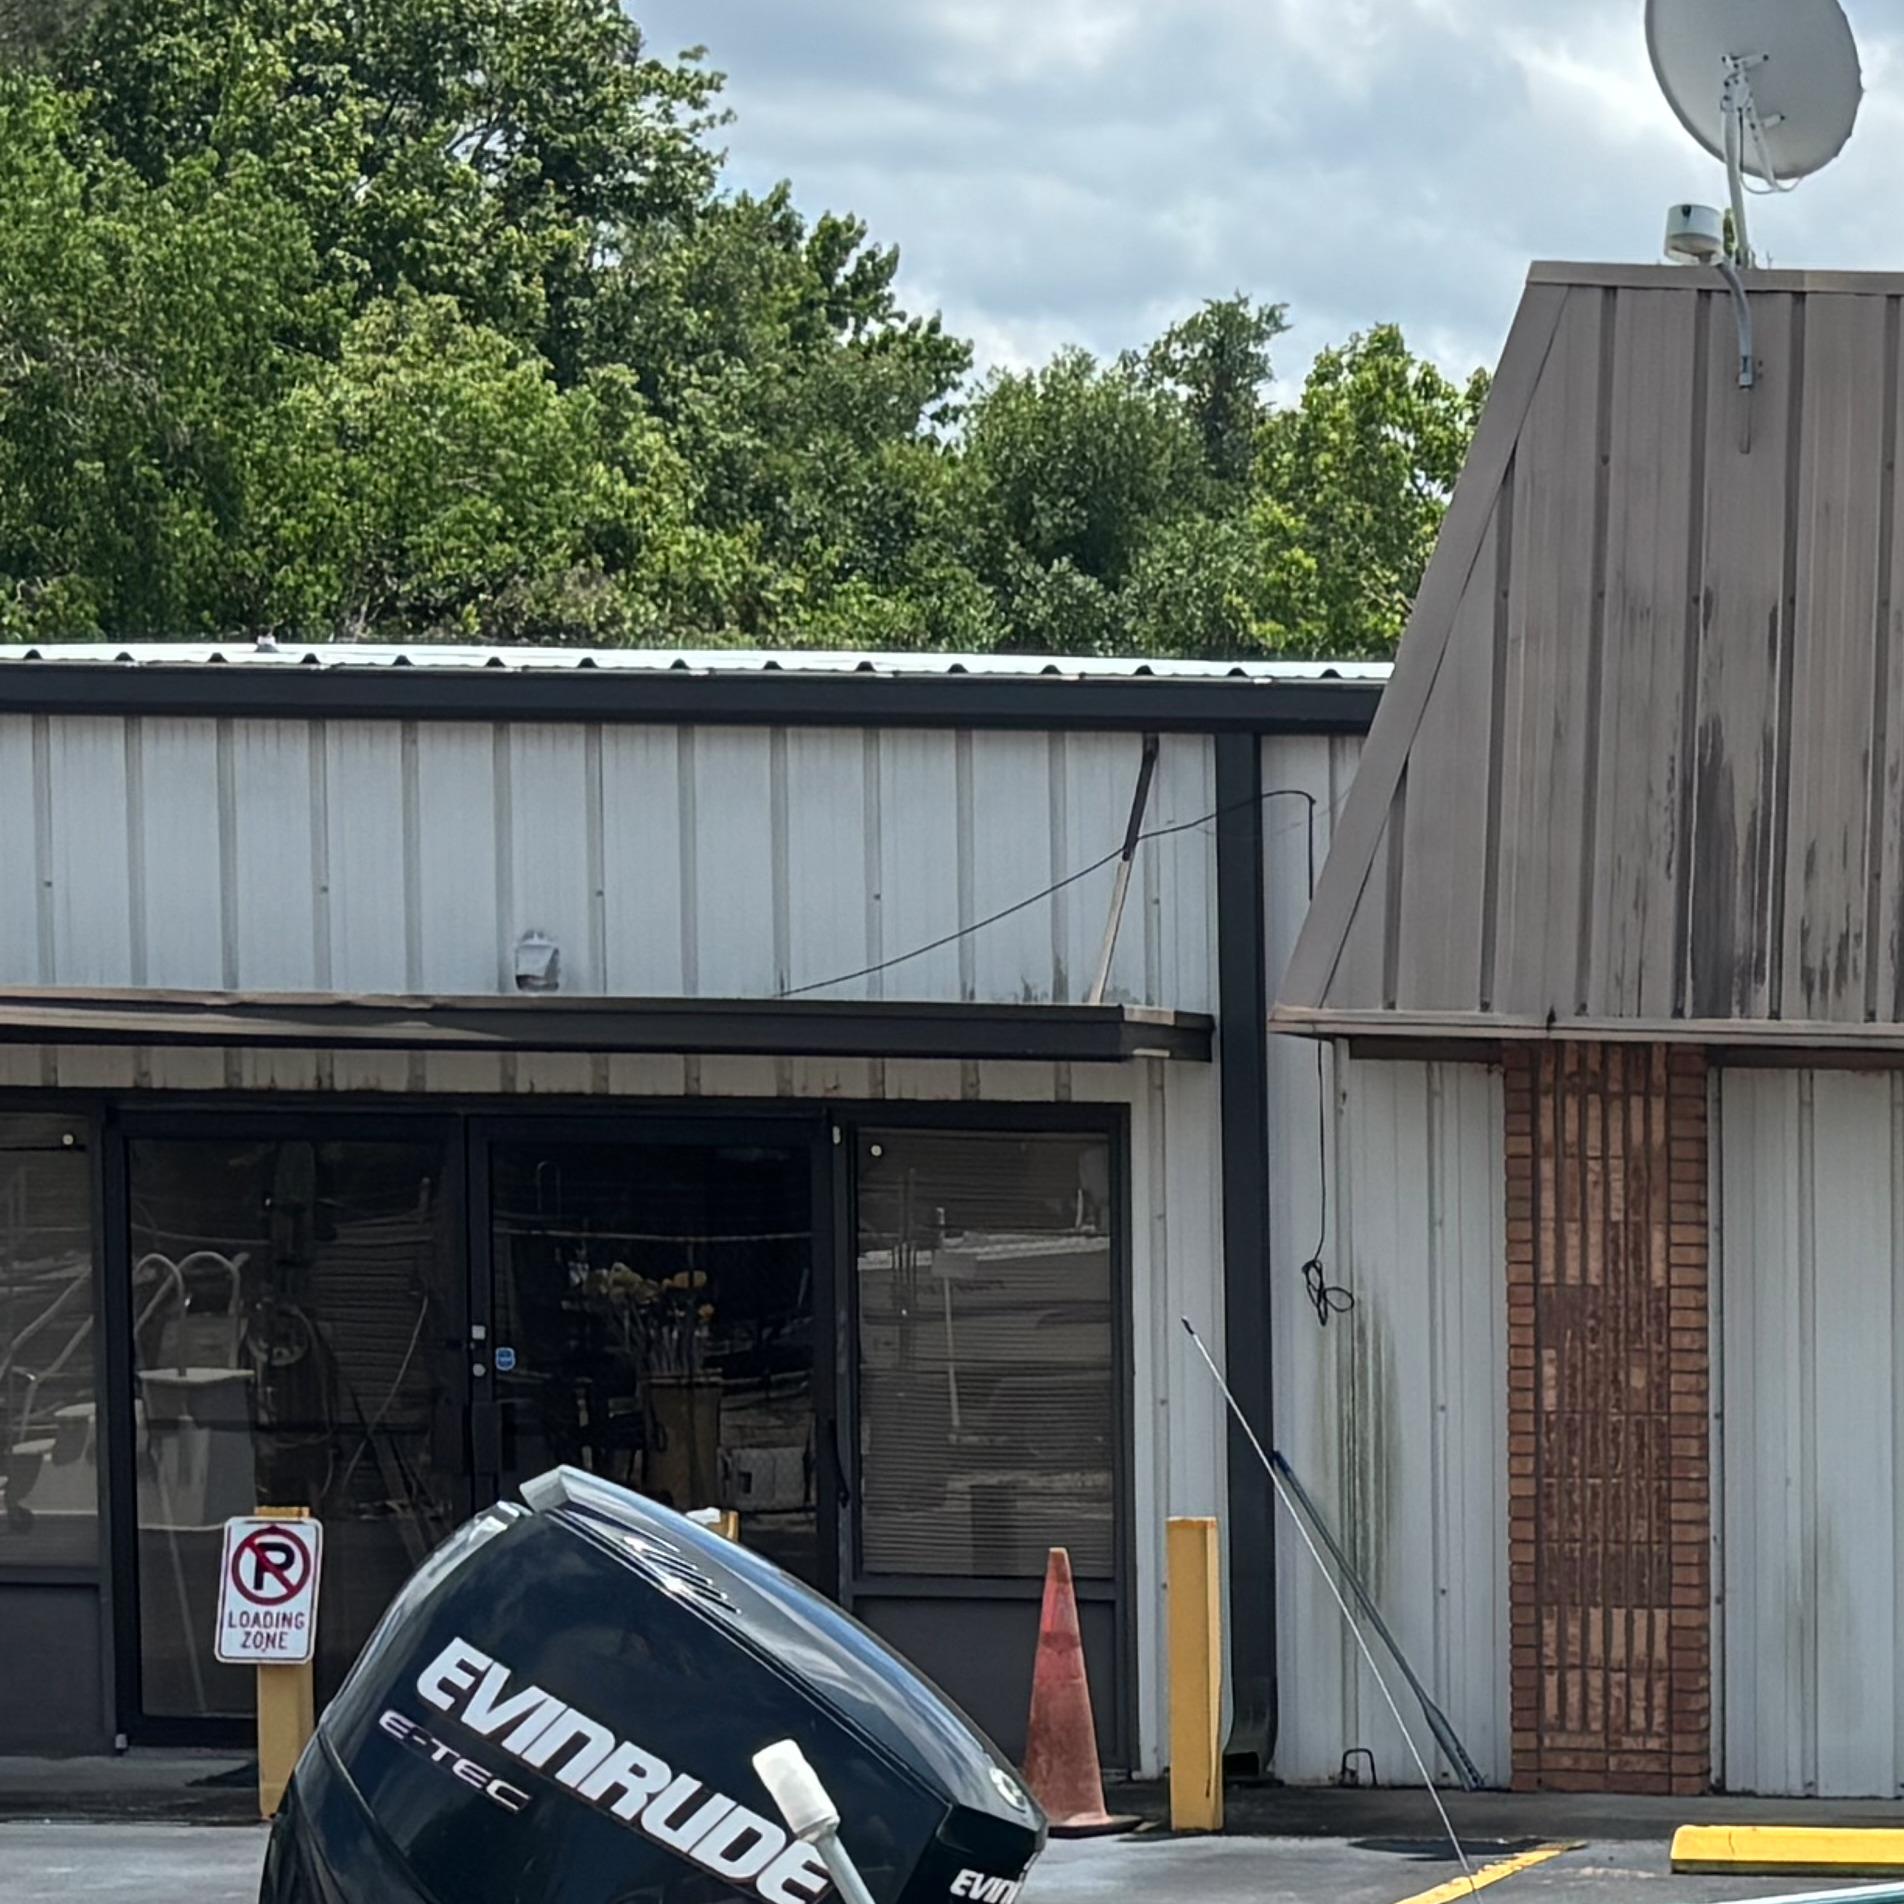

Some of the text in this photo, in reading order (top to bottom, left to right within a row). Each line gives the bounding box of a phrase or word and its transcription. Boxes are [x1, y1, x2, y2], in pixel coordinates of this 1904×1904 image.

[228, 1611, 306, 1629] LOADING
[241, 1632, 288, 1650] ZONE
[379, 1709, 532, 1813] E-TEC
